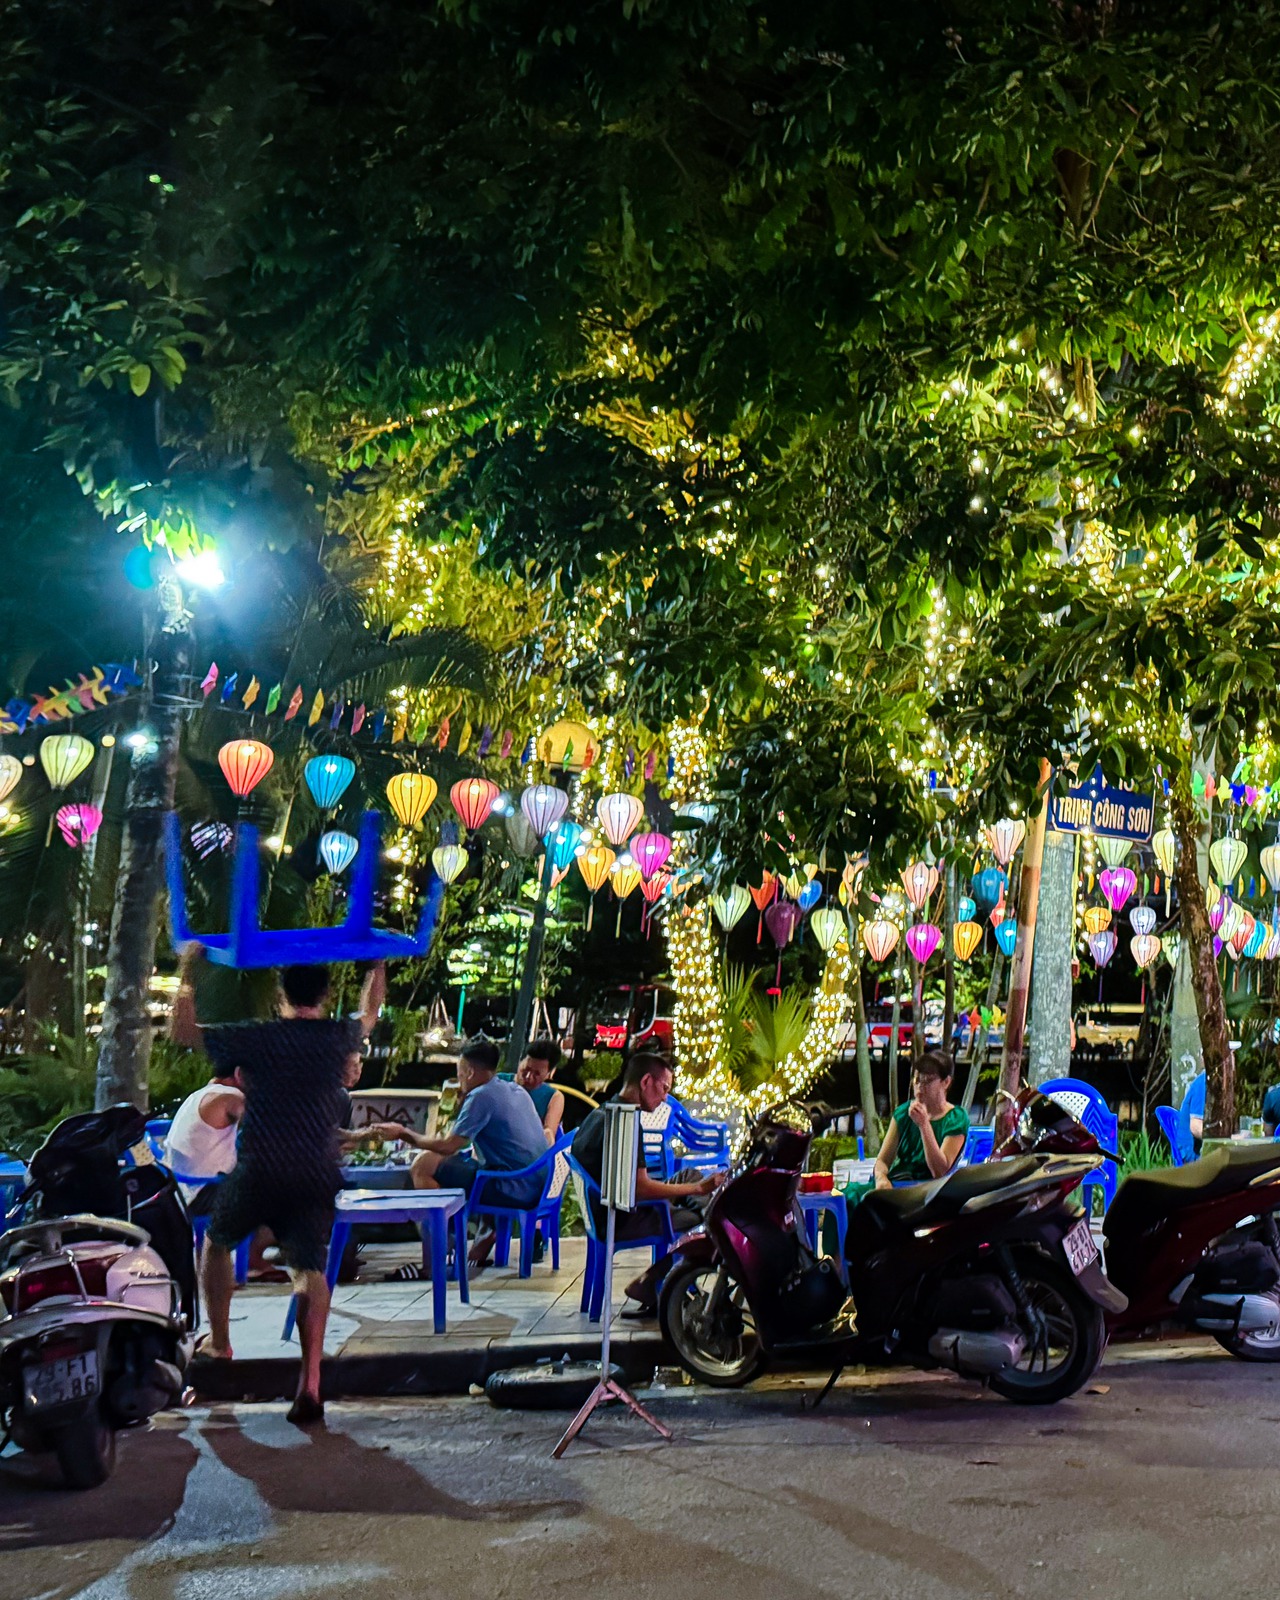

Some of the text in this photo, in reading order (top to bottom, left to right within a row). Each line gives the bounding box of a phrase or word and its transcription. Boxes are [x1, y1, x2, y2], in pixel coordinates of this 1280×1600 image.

[1058, 796, 1150, 833] TRỊNH CÔNG SƠN
